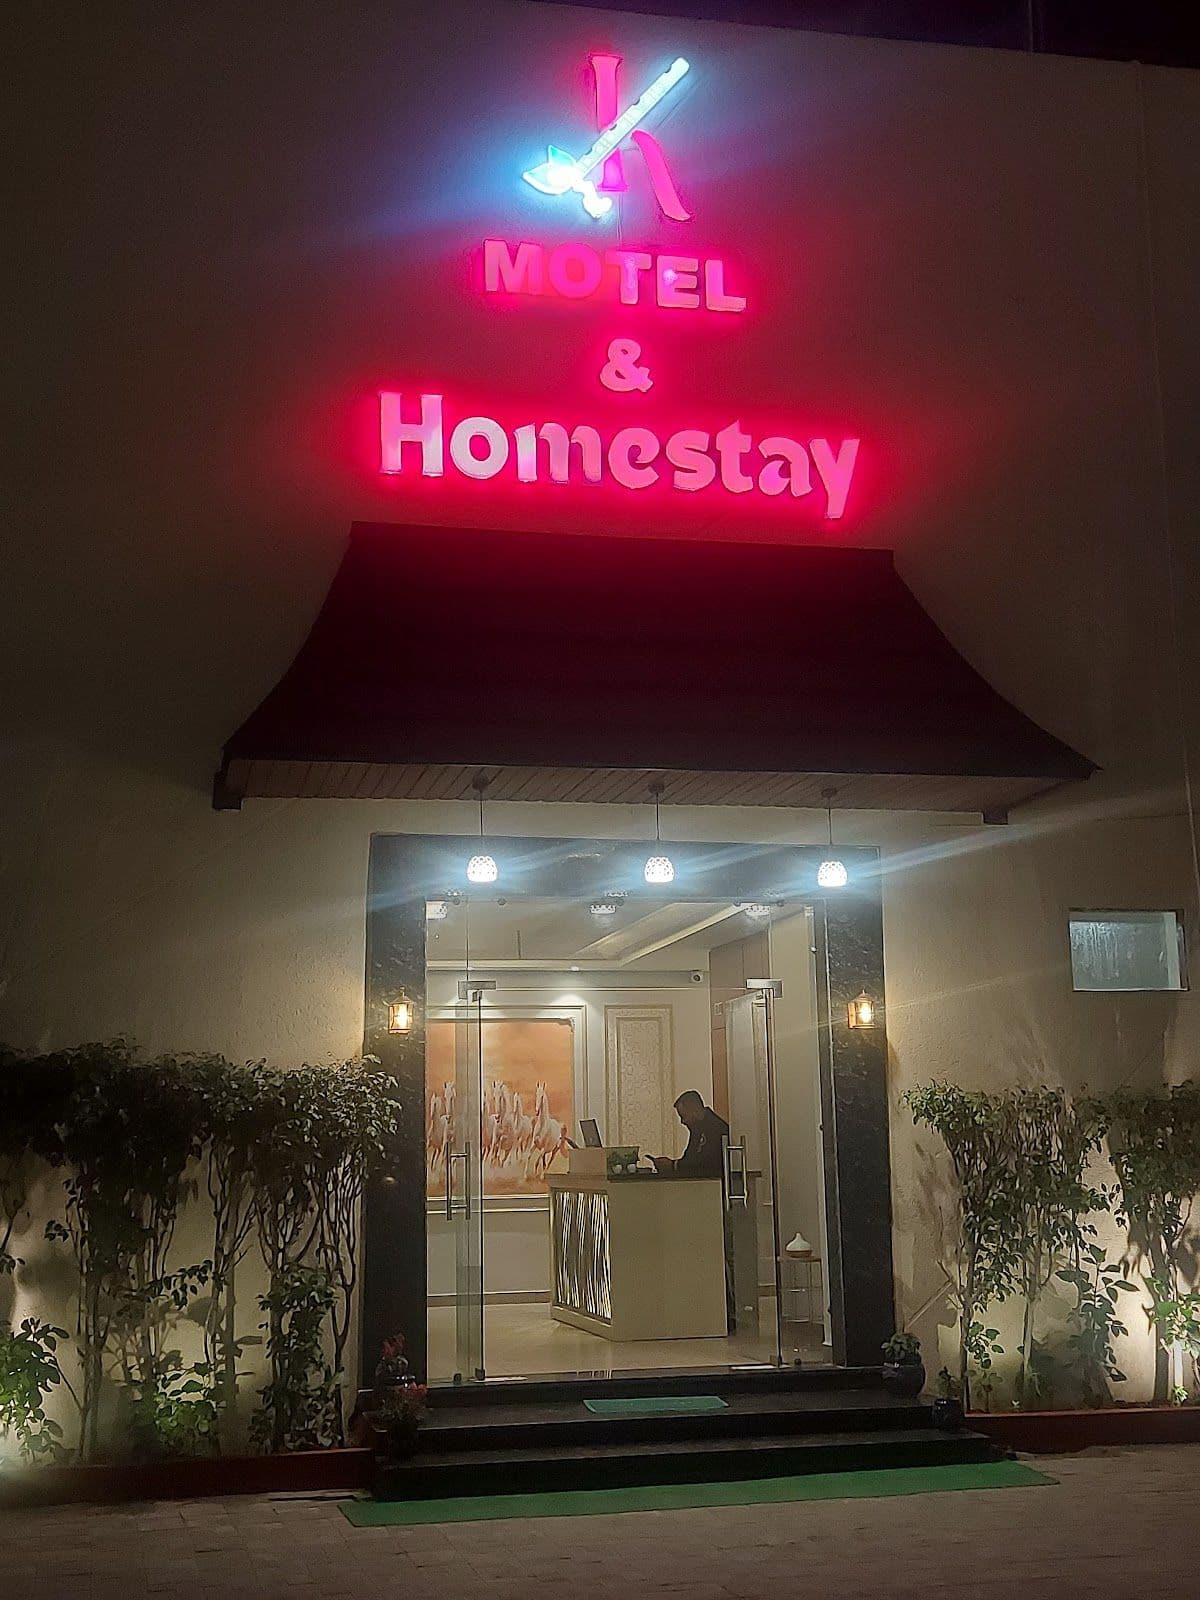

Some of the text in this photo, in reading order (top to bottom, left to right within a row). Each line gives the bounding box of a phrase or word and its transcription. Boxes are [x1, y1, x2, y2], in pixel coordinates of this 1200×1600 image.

[483, 240, 747, 312] MOTEL
[600, 338, 654, 393] &
[379, 391, 861, 519] Homestay
